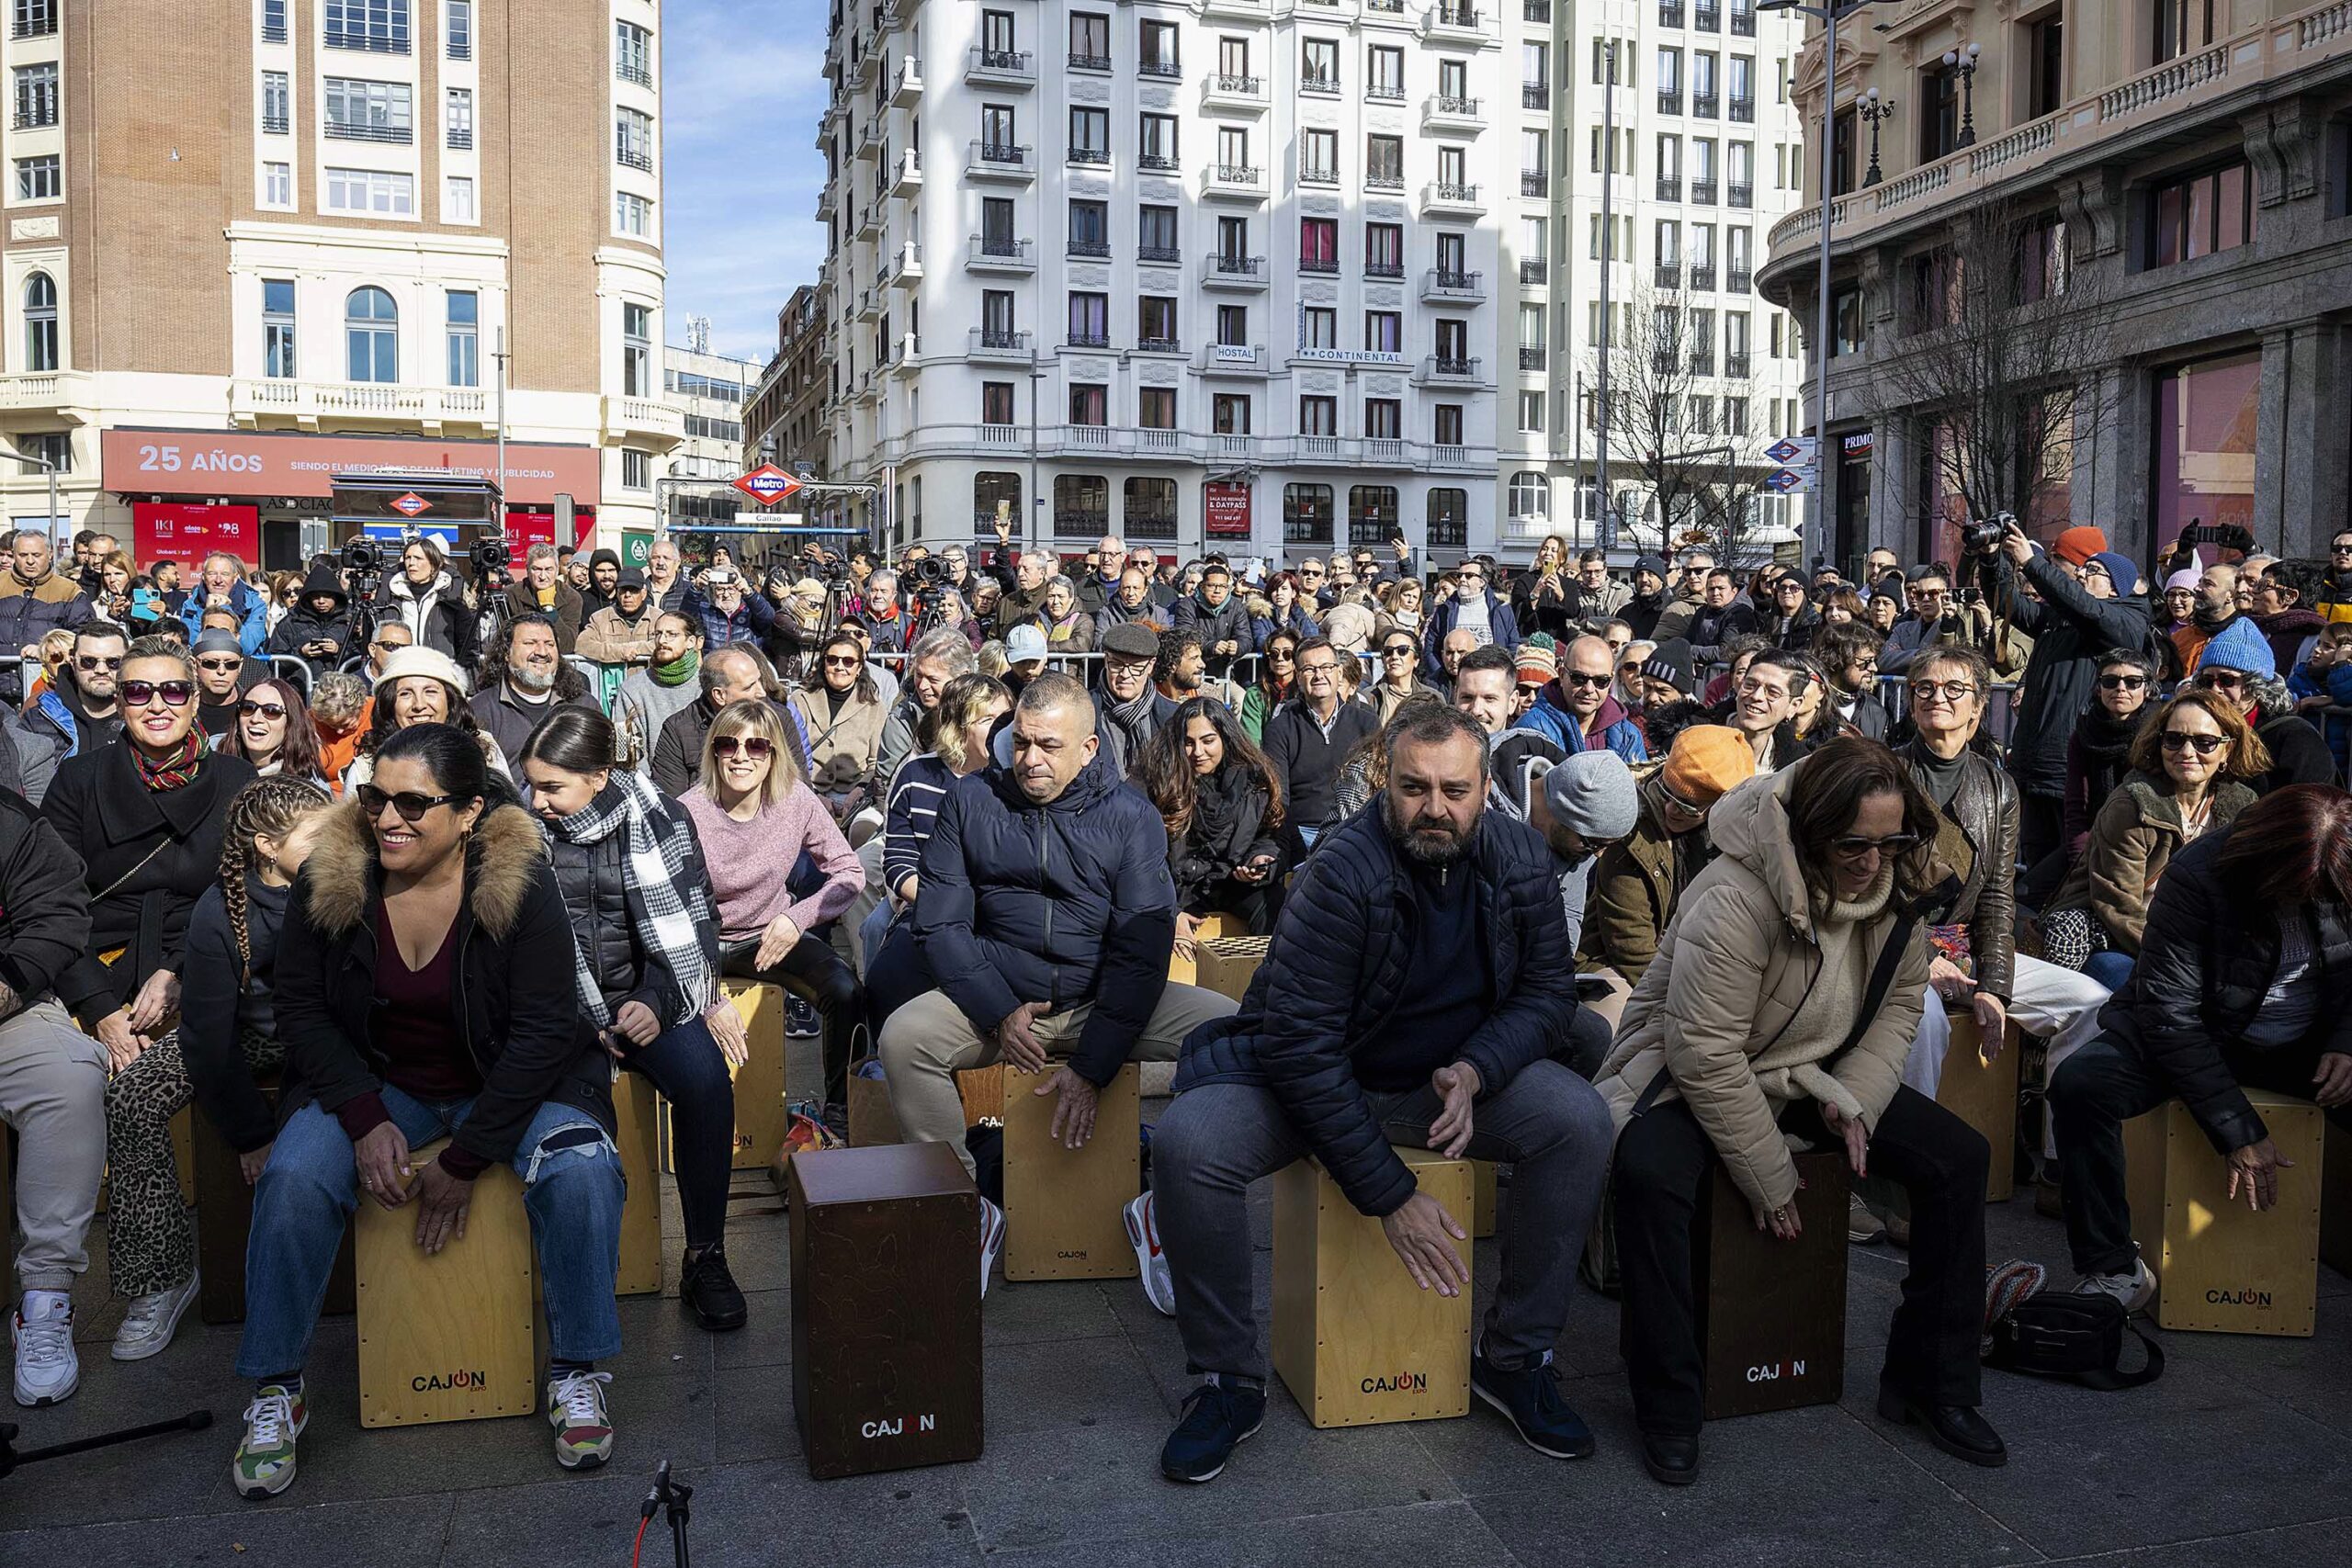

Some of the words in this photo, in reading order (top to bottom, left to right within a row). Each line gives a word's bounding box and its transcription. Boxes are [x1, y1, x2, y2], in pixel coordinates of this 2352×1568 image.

[1217, 348, 1254, 358] HOSTAL
[1318, 350, 1401, 363] CONTINENTAL
[1845, 433, 1873, 449] PRIMO
[139, 445, 182, 471] 25
[190, 448, 263, 473] AÑOS
[290, 461, 330, 471] SIENDO
[332, 463, 343, 471] EL
[486, 468, 493, 477] Y
[752, 479, 784, 490] Metro
